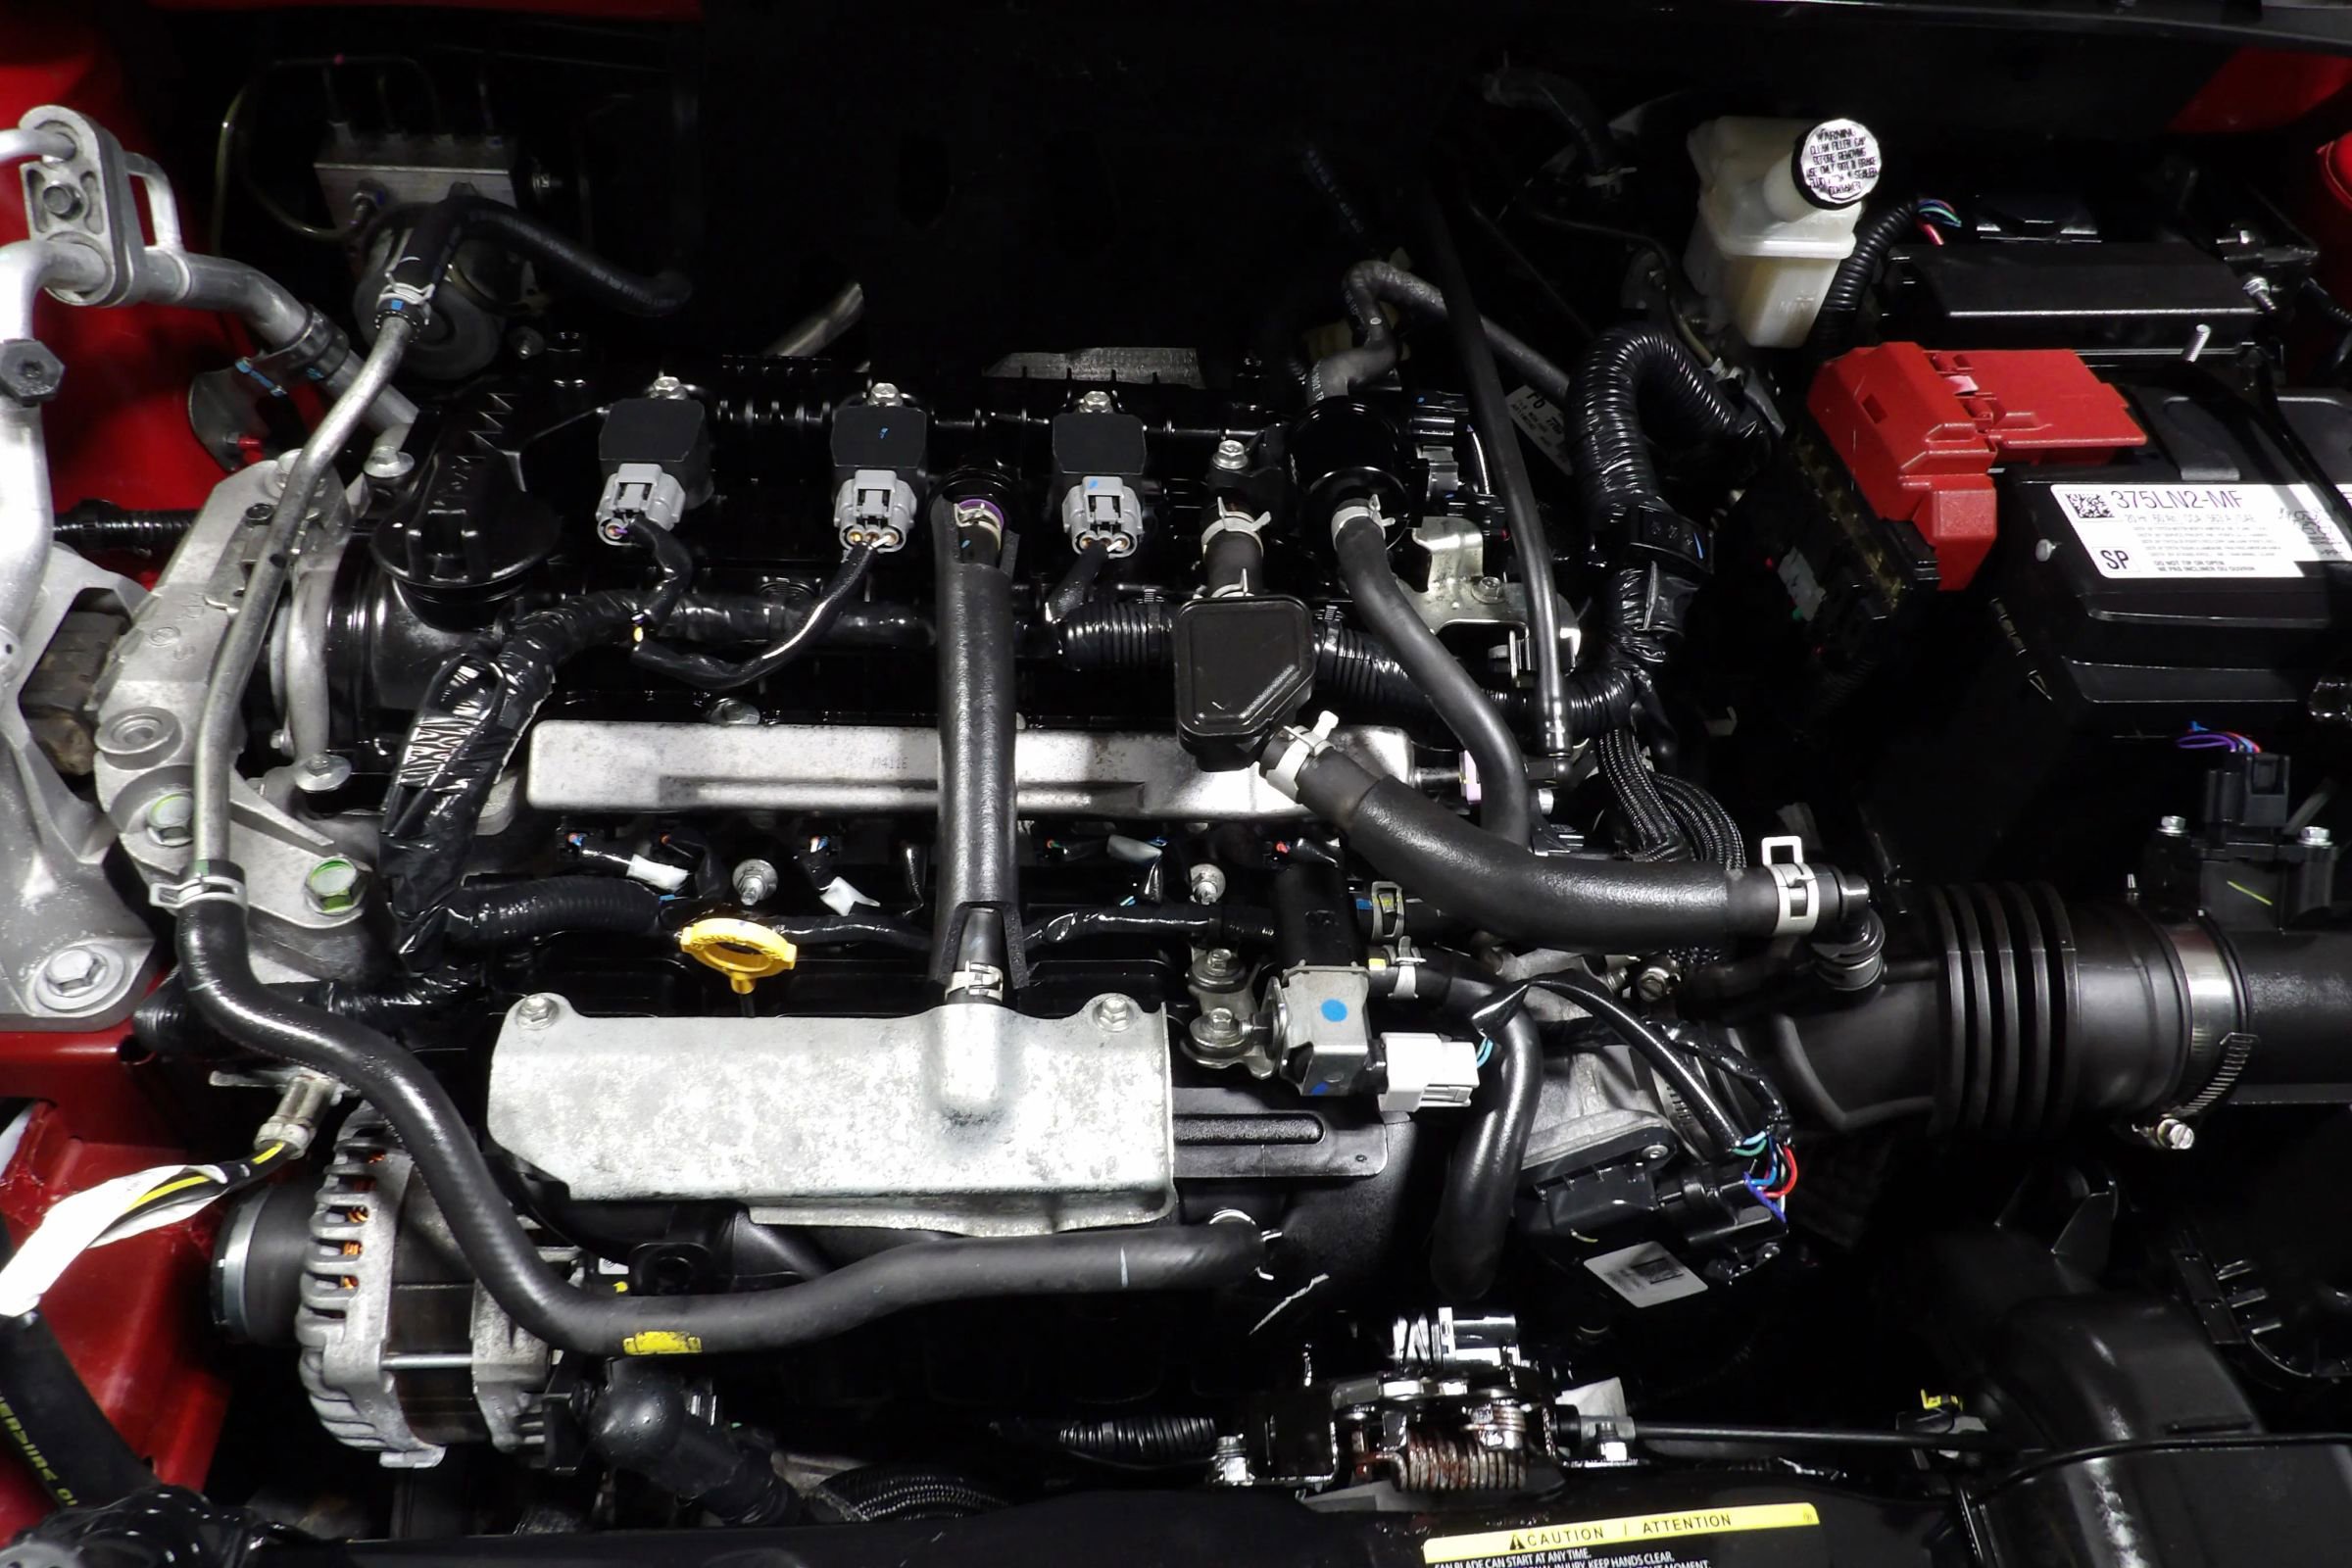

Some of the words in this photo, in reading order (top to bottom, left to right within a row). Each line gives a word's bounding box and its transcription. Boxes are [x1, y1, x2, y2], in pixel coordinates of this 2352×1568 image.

[2110, 490, 2243, 509] 375LN2-MF
[2100, 550, 2129, 569] SP
[1527, 1526, 1604, 1546] CAUTION
[1642, 1513, 1732, 1535] ATTENTION
[1485, 1557, 1506, 1568] CAN
[1506, 1553, 1534, 1568] START
[1535, 1552, 1546, 1564] AT
[1547, 1549, 1566, 1563] ANY
[1566, 1546, 1592, 1560] TIME.
[1589, 1557, 1610, 1568] KEEP
[1610, 1553, 1643, 1568] HANDS
[1643, 1550, 1675, 1564] CLEAR.
